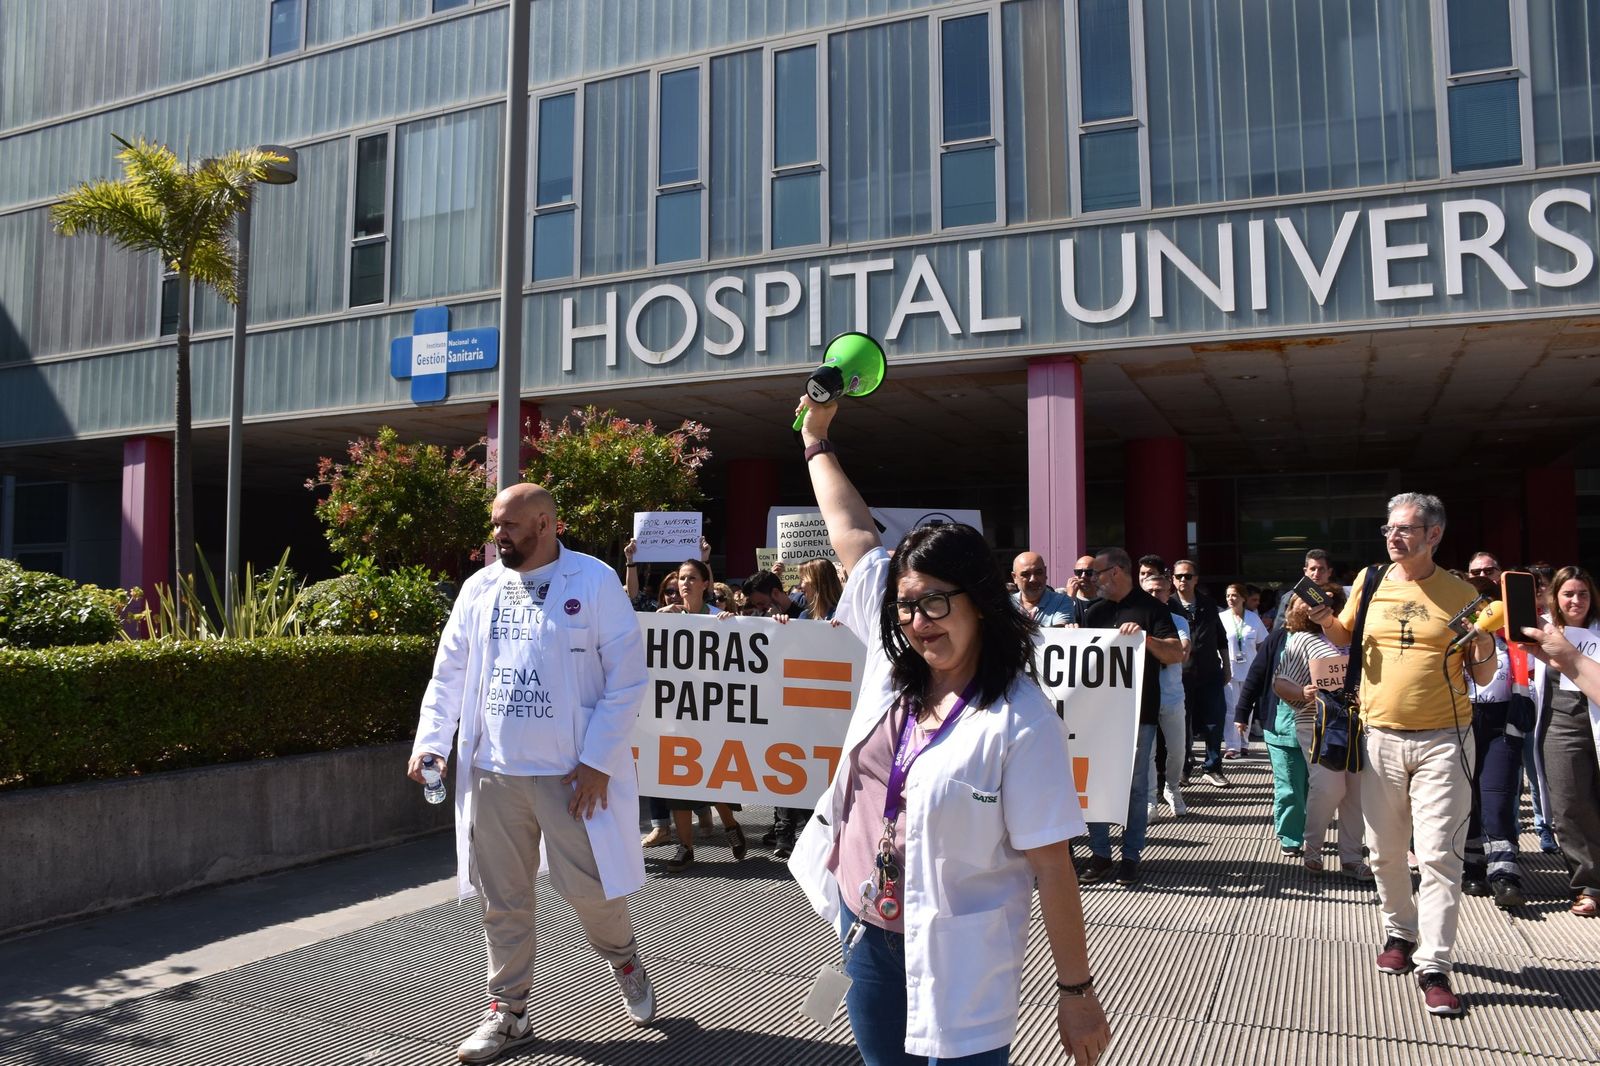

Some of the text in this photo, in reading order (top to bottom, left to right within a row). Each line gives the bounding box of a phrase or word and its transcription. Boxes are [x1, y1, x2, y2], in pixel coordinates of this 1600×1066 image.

[562, 187, 1594, 372] HOSPITAL UNIVERS
[426, 341, 446, 350] Instituto
[448, 338, 470, 347] Nacional
[416, 347, 484, 366] Gestión Sanitaria
[793, 539, 824, 547] SUFREN
[781, 548, 836, 559] CIUDADANO
[489, 627, 508, 640] ER
[511, 628, 533, 641] DEL
[646, 628, 769, 674] HORAS
[1328, 664, 1339, 674] 35
[492, 667, 541, 687] PENA
[486, 688, 552, 704] BANDON
[654, 679, 769, 725] PAPEL
[972, 792, 998, 803] SATSE
